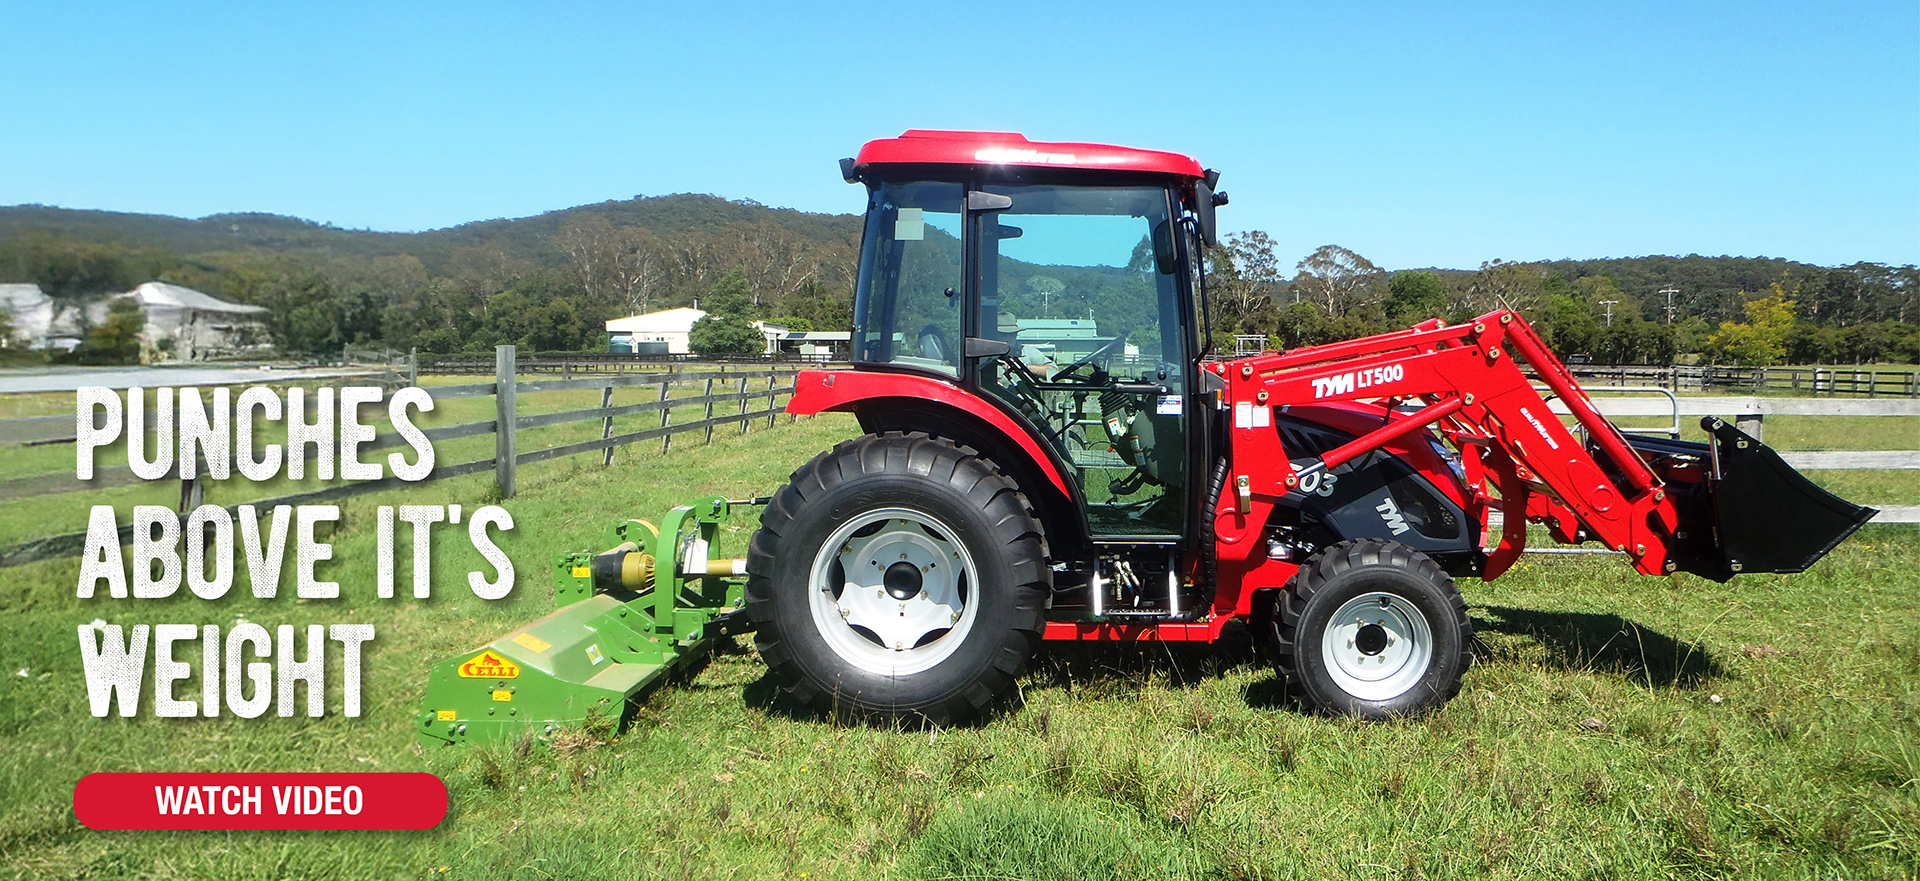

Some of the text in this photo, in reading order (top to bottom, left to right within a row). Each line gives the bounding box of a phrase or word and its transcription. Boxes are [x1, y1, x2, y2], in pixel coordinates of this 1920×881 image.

[1311, 364, 1403, 399] TYM LT500
[1289, 462, 1338, 498] 03
[1375, 497, 1410, 536] TYM
[462, 662, 516, 677] CELLI
